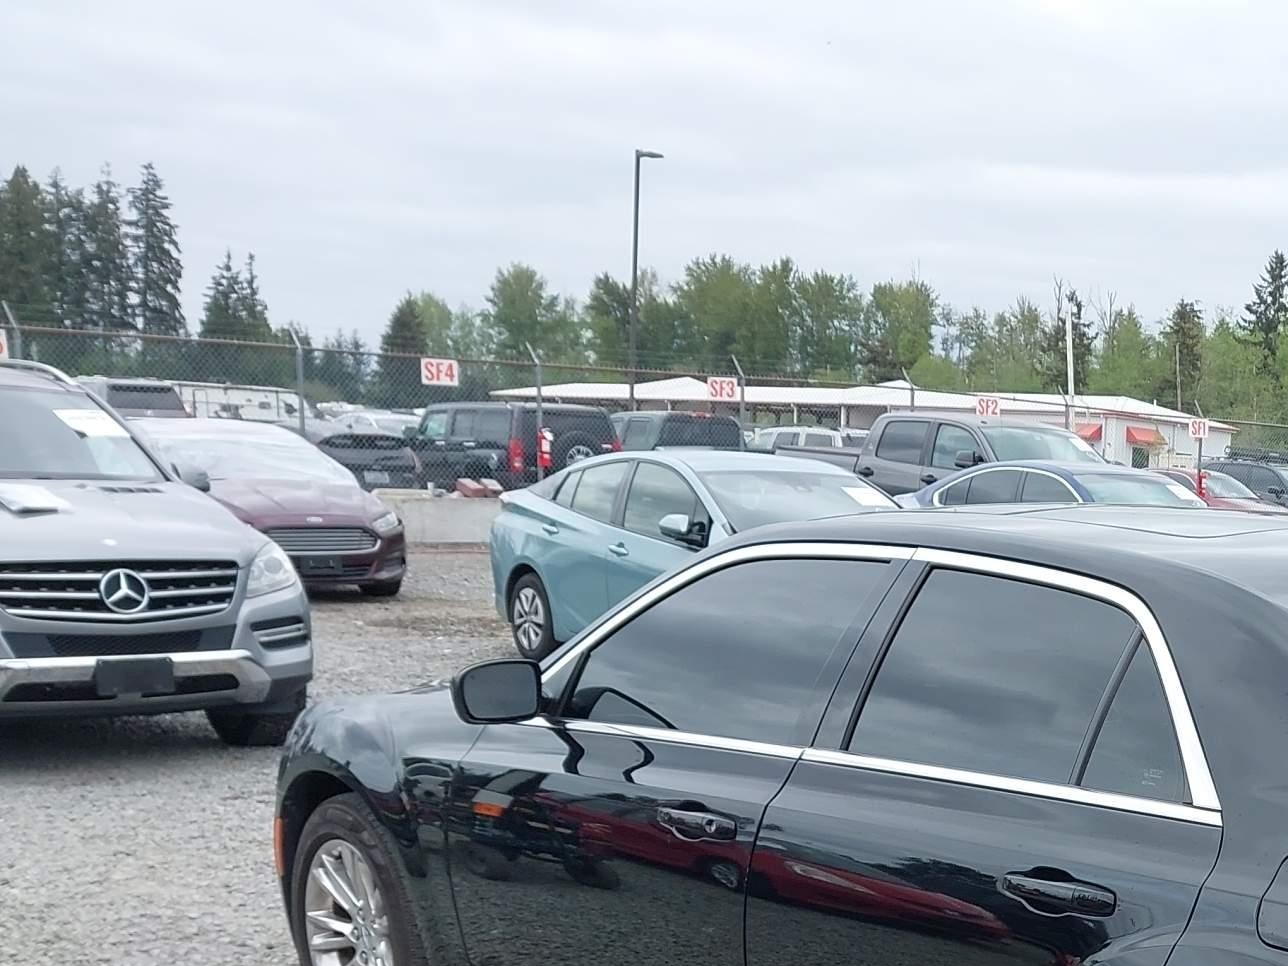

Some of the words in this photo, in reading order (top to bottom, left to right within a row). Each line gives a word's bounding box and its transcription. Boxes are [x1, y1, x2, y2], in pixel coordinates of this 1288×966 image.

[424, 361, 456, 382] SF4
[710, 380, 735, 398] SF3
[978, 398, 999, 416] SF2
[1191, 420, 1206, 437] SF1
